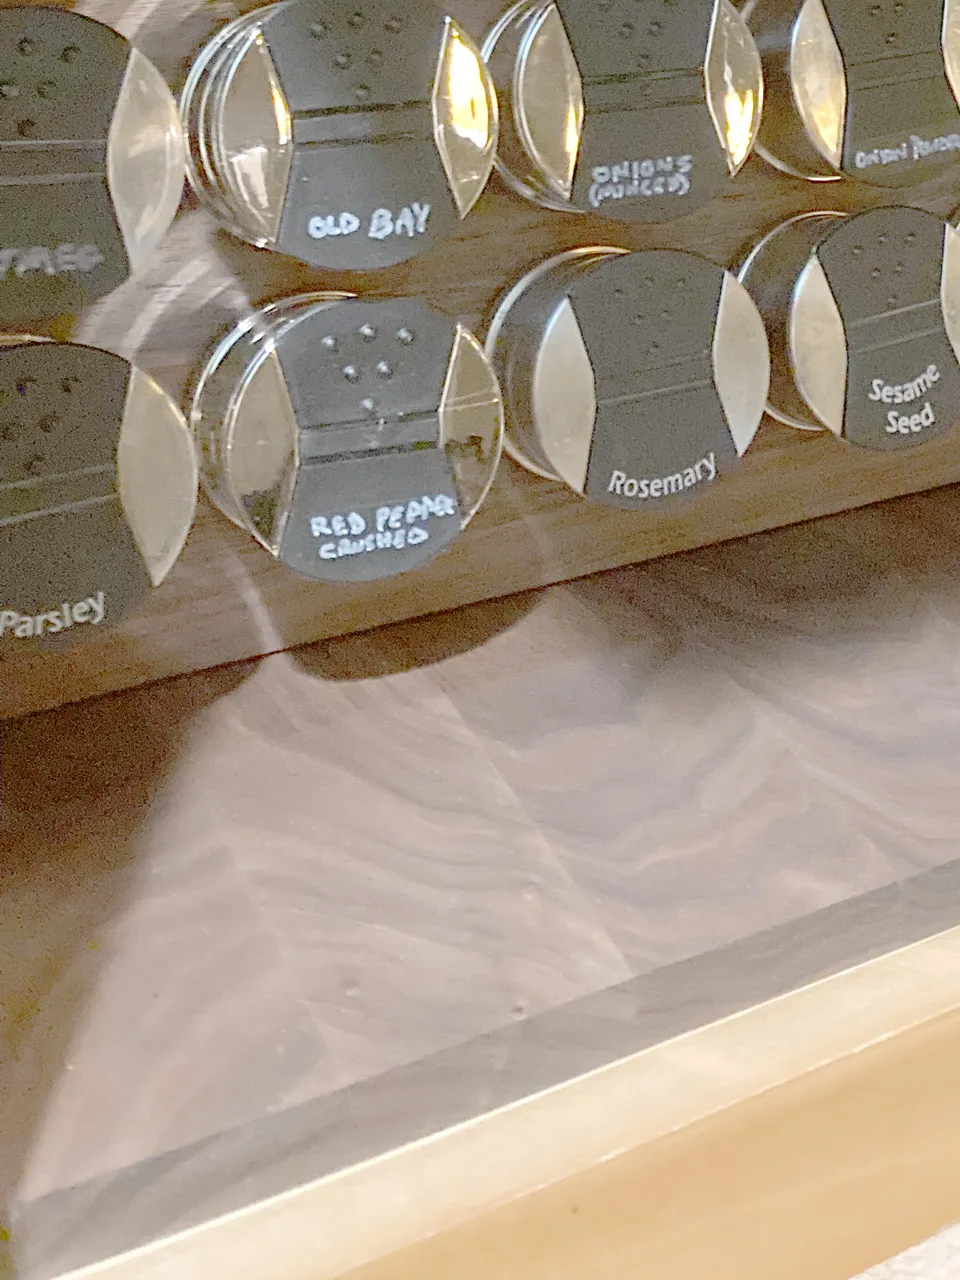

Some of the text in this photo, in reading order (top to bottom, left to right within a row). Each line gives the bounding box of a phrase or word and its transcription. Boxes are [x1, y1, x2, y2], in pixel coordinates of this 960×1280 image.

[308, 201, 431, 240] OLD BAY
[868, 364, 941, 404] Sesame
[885, 402, 936, 435] Seed
[608, 452, 717, 499] Rosemary
[311, 512, 366, 538] RED
[0, 591, 106, 638] Parsley
